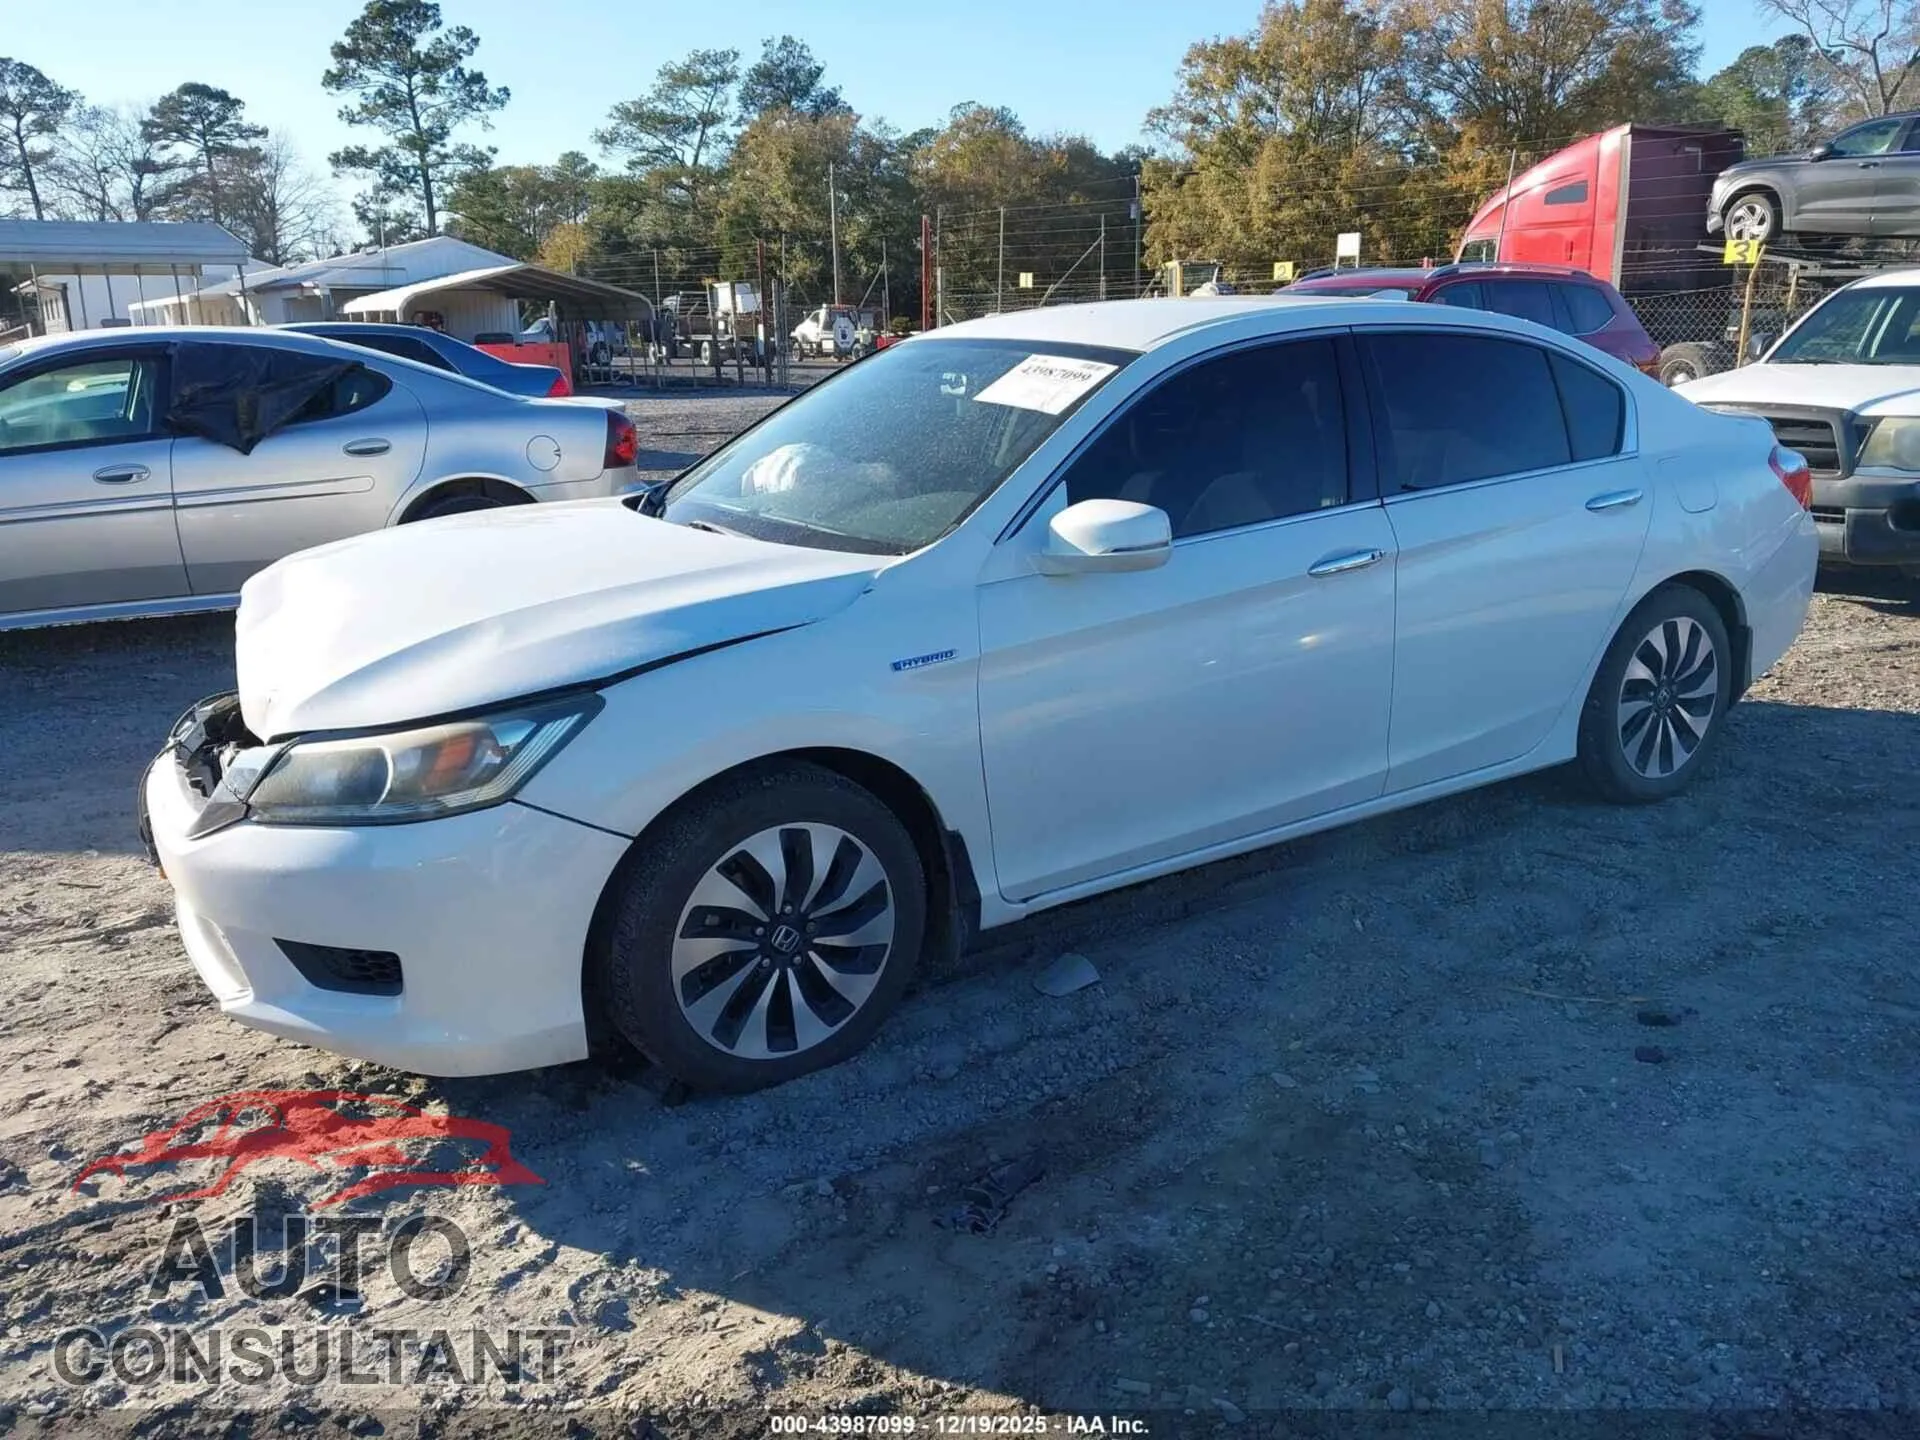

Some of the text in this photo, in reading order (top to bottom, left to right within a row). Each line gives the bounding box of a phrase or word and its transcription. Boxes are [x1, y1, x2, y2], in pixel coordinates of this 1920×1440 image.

[1733, 241, 1750, 263] 3
[1278, 264, 1288, 279] 2
[899, 650, 956, 670] HYBRID
